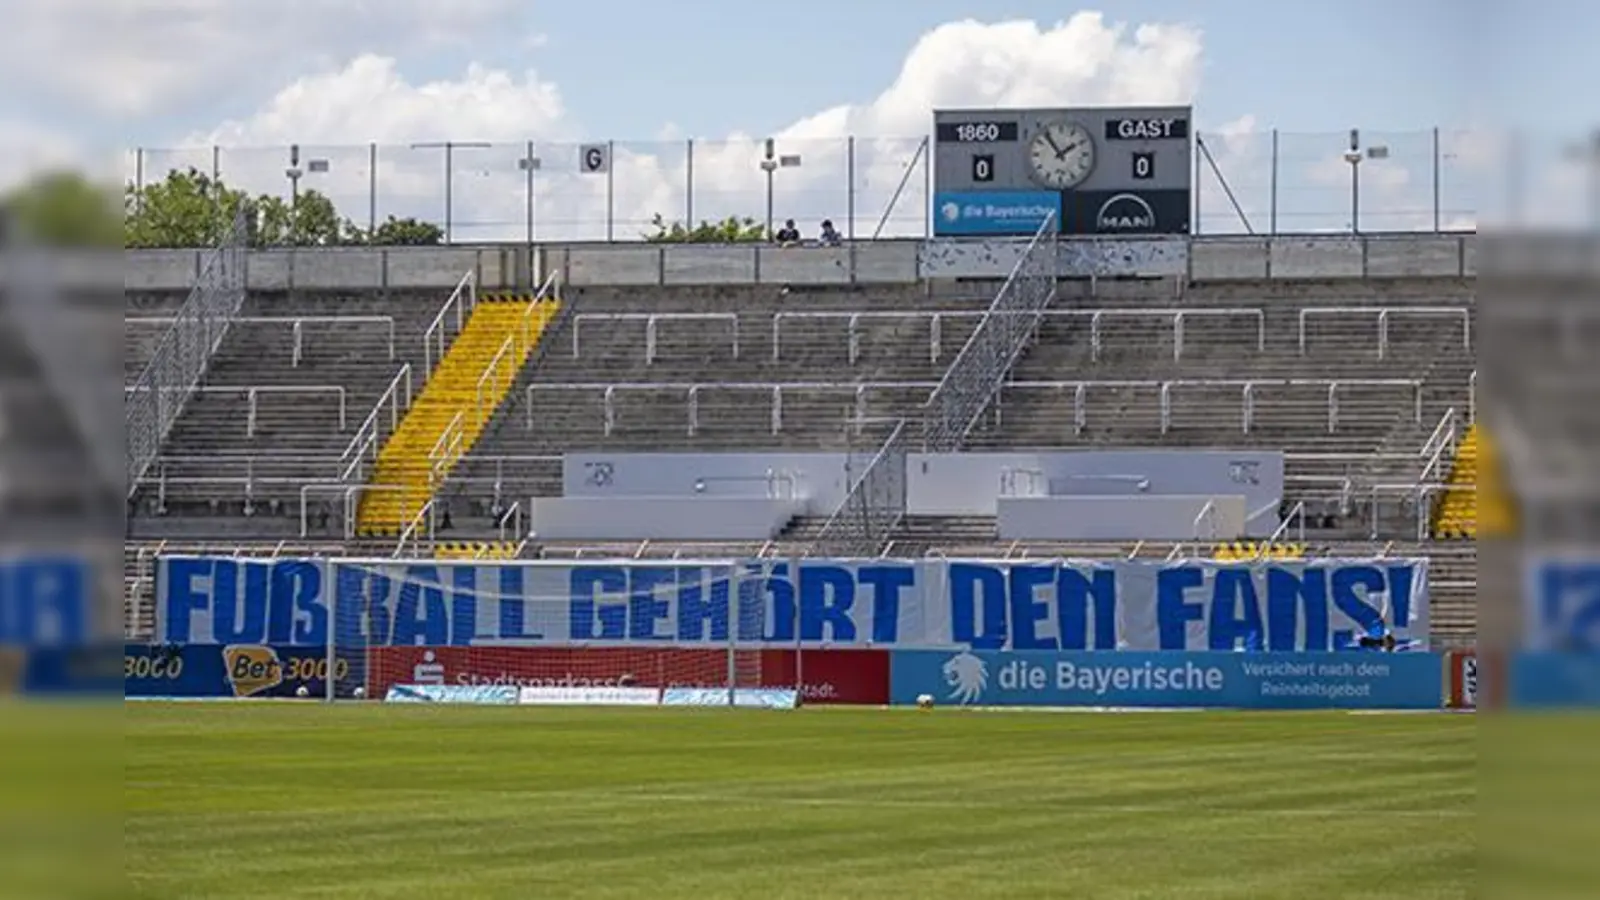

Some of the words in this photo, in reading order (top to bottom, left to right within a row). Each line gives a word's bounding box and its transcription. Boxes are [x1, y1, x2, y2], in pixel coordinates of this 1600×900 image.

[956, 124, 998, 140] 1860
[1118, 119, 1174, 137] GAST
[586, 148, 602, 172] G
[976, 160, 989, 178] 0
[1136, 157, 1149, 176] 0
[962, 204, 982, 217] die
[1102, 216, 1149, 228] MAN
[950, 562, 1116, 650] DEN
[1157, 563, 1416, 650] FANS!
[233, 655, 281, 680] Bet
[282, 657, 349, 681] 3000
[1242, 661, 1316, 677] Versichert
[1318, 661, 1354, 677] nach
[1356, 661, 1391, 677] dem
[1000, 661, 1048, 690] die
[1056, 661, 1224, 695] Bayerische
[1260, 681, 1371, 699] Reinheitsgebot
